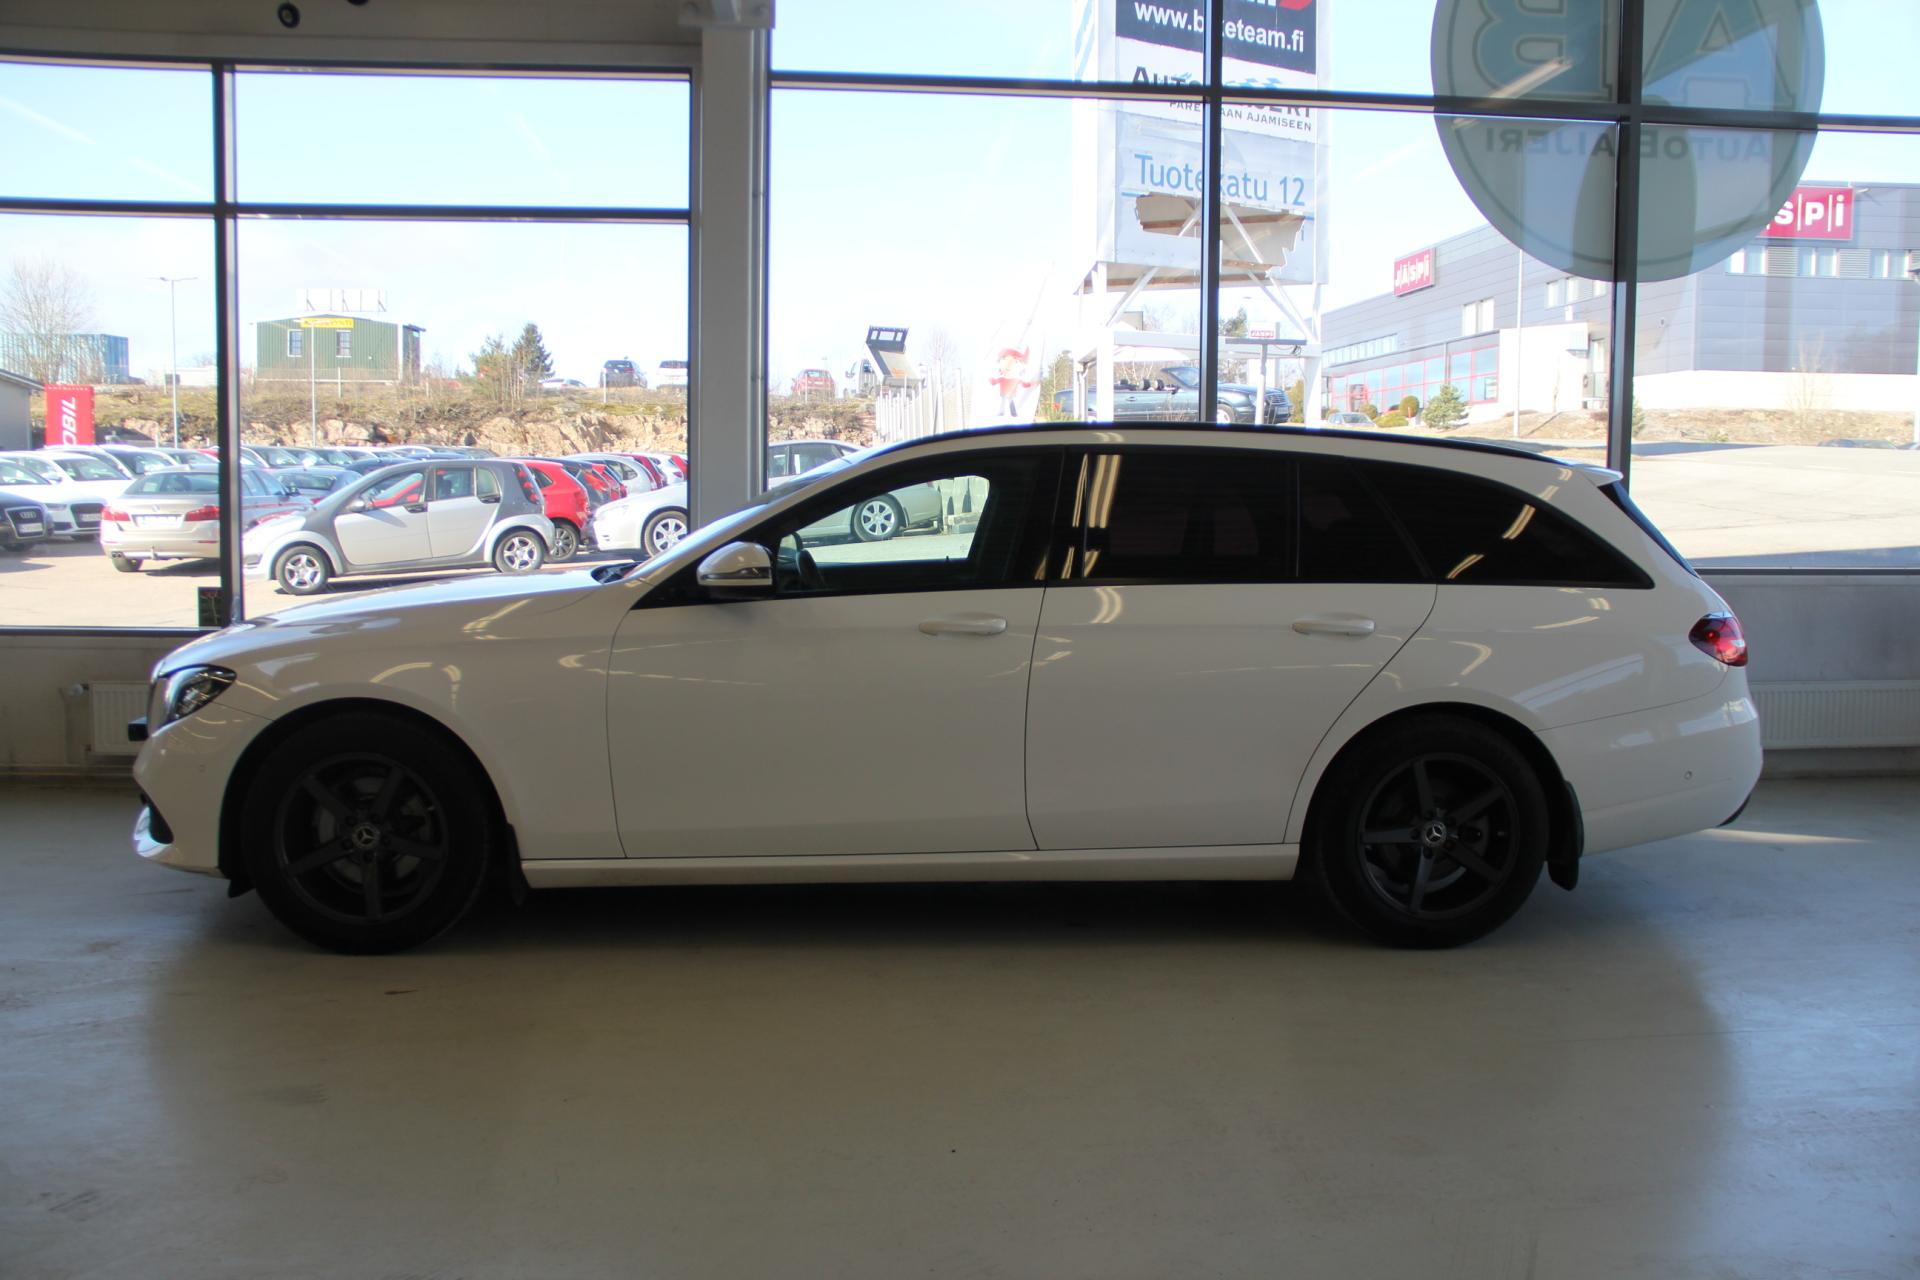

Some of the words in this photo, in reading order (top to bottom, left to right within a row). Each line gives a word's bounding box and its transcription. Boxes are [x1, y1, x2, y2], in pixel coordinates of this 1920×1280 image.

[1134, 2, 1304, 52] www.beteam.fi
[1169, 101, 1242, 120] PAREAAN
[1246, 112, 1312, 131] AJAMISEEN
[1279, 176, 1305, 206] 12
